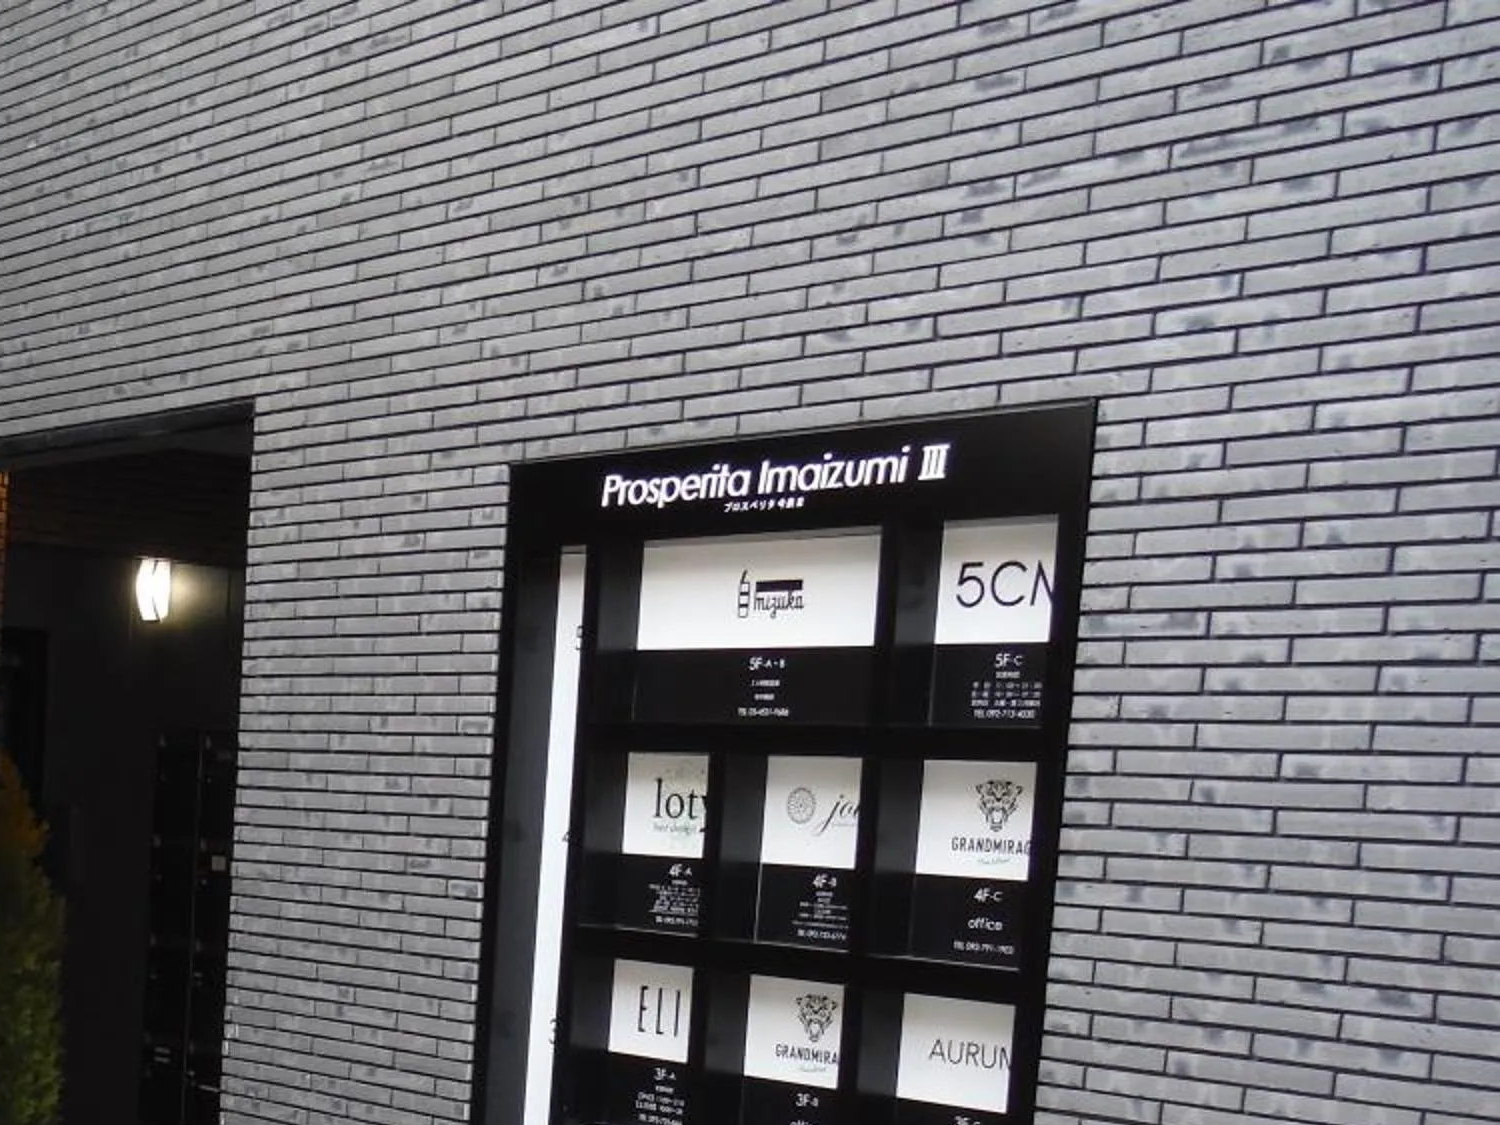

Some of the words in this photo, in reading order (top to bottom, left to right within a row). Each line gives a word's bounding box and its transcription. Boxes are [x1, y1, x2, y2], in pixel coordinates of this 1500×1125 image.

[601, 463, 751, 509] Prosperita
[757, 446, 912, 495] Imaizumi
[967, 917, 1004, 931] office
